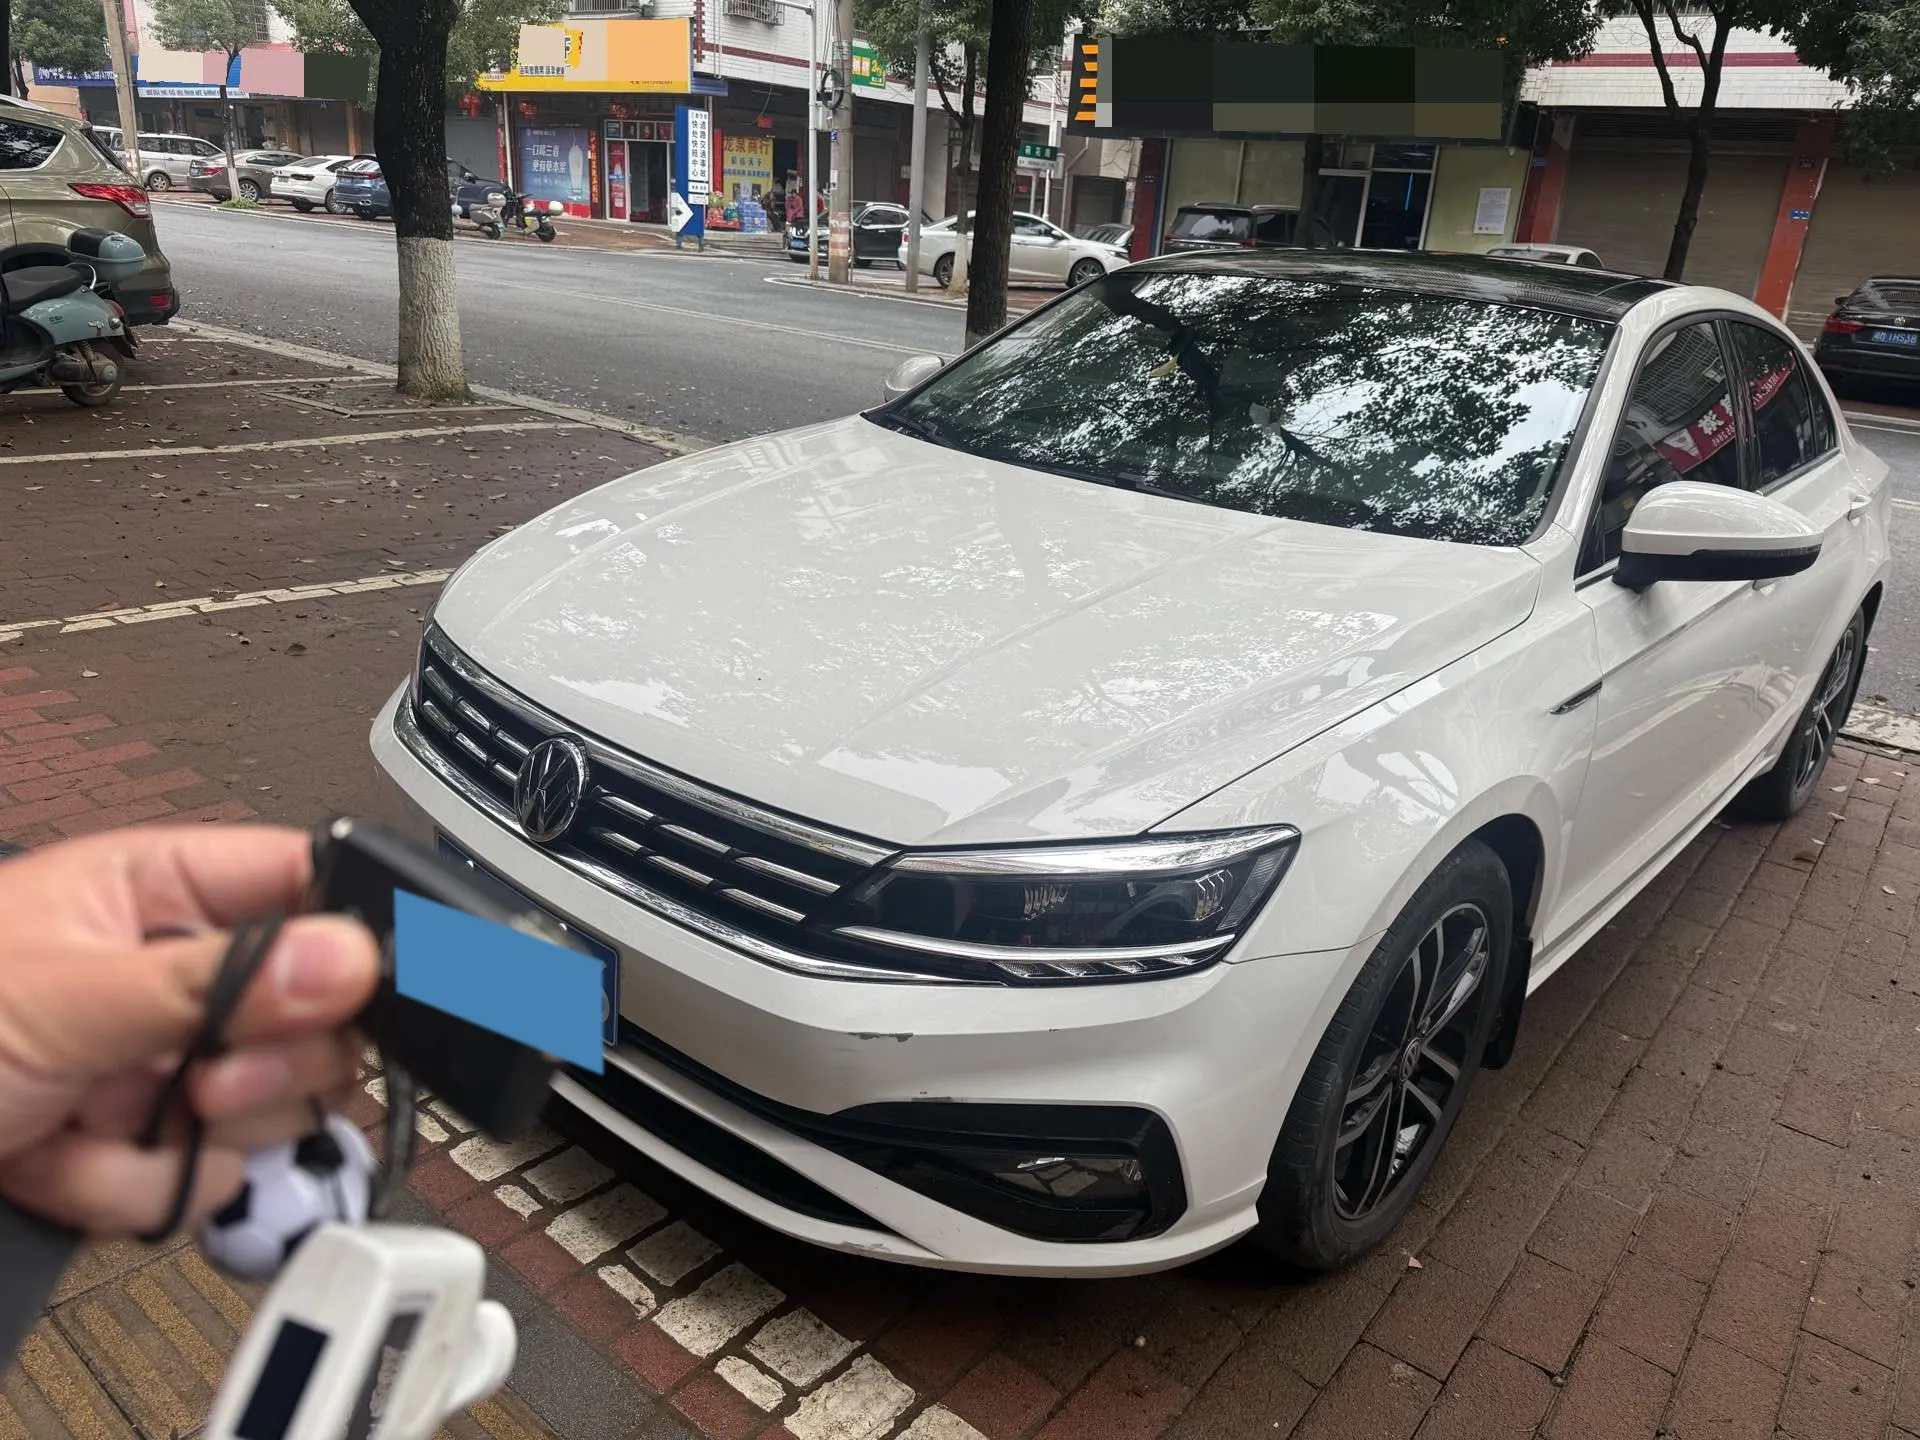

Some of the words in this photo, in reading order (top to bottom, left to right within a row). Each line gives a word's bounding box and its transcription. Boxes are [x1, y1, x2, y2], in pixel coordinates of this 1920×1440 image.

[691, 120, 699, 177] 快处快赔中心
[699, 120, 707, 177] 道路交通事故
